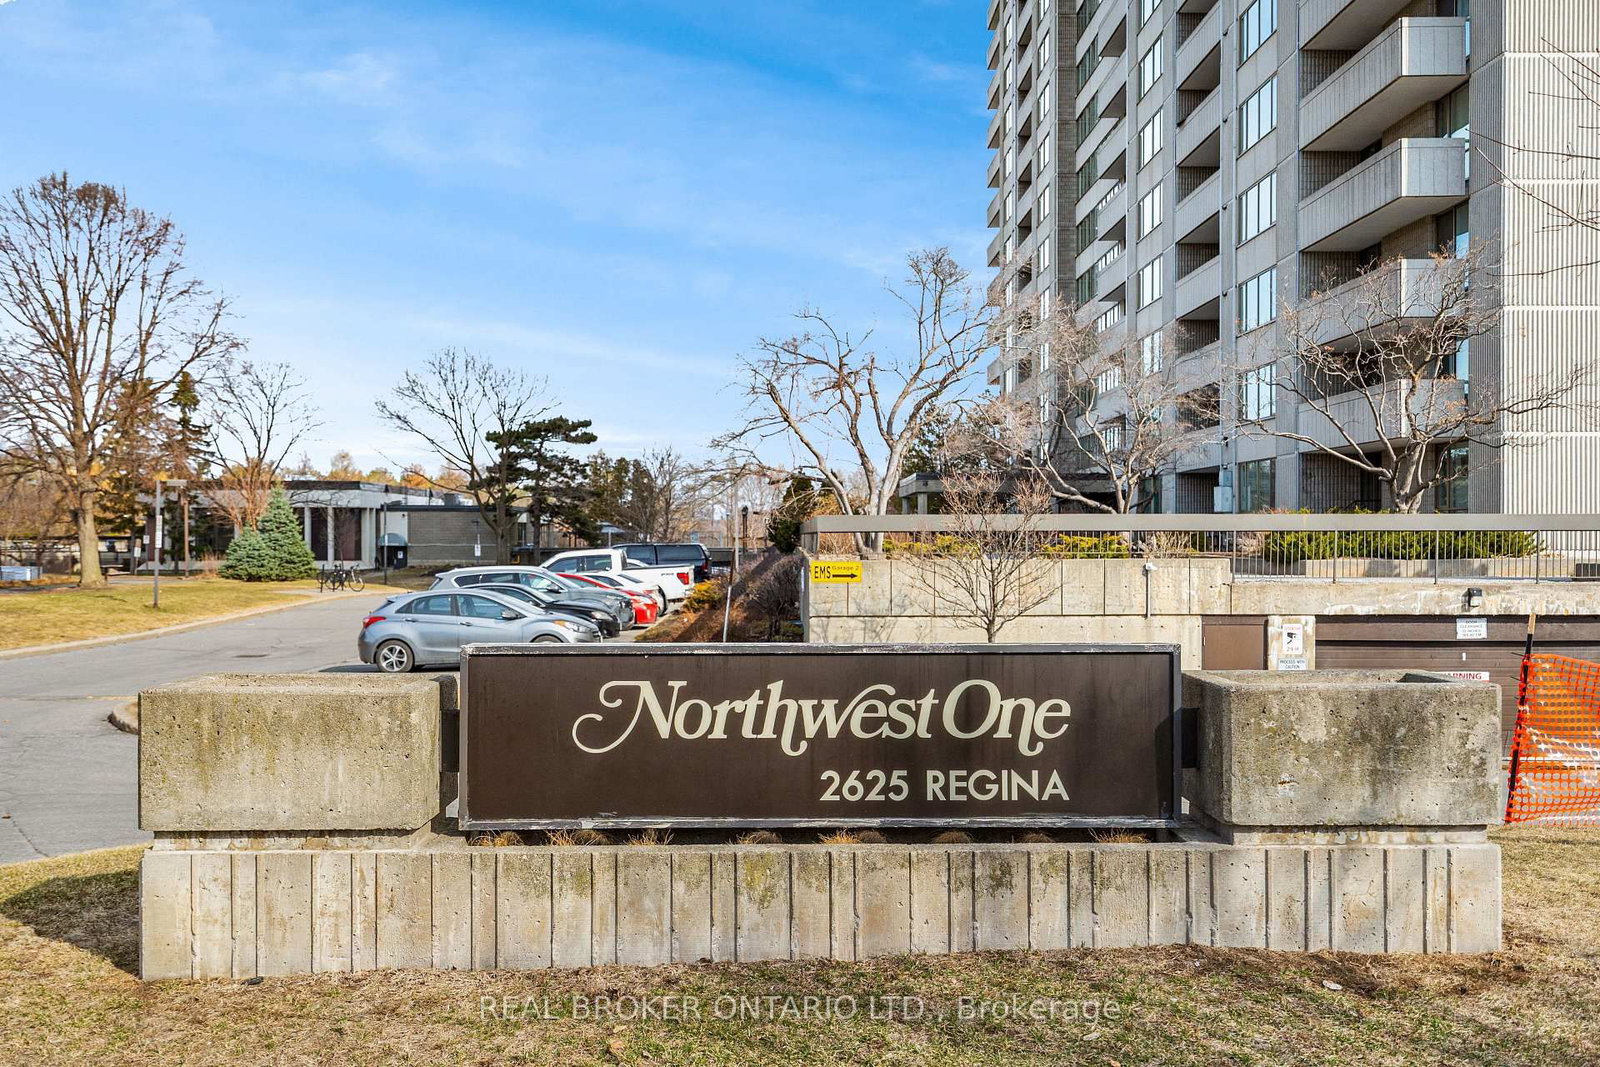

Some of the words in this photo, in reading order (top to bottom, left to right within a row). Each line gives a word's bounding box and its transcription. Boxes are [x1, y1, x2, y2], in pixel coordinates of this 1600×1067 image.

[814, 565, 831, 579] EMS
[1446, 672, 1482, 680] RNING
[819, 769, 909, 802] 2625
[926, 769, 1070, 802] REGINA
